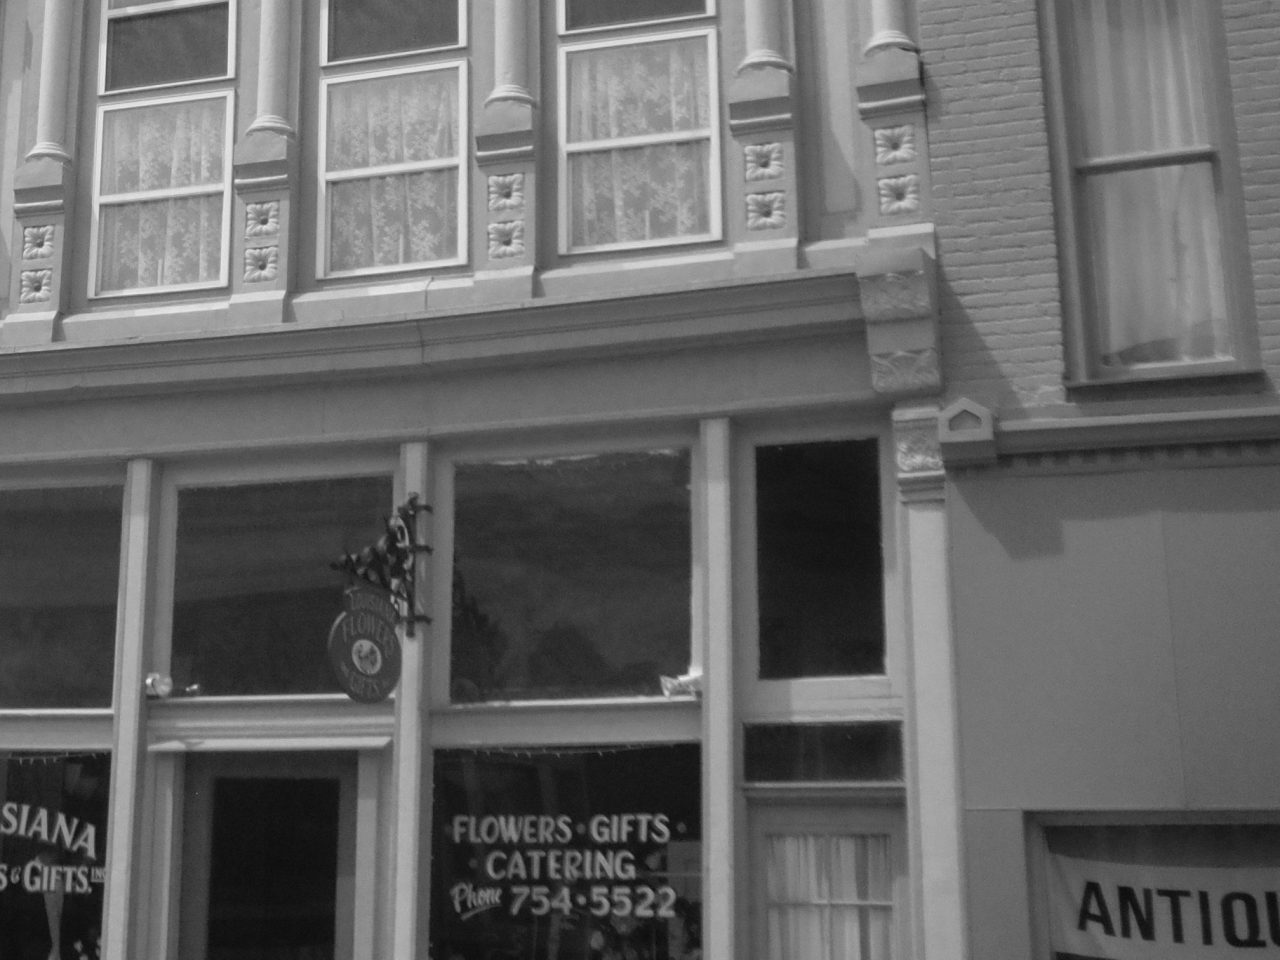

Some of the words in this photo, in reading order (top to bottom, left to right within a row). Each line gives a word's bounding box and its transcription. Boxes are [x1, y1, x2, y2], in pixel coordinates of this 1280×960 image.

[452, 814, 573, 844] FLOWERS
[590, 813, 671, 844] GIFTS
[486, 849, 637, 881] CATERING
[450, 882, 503, 916] Phone
